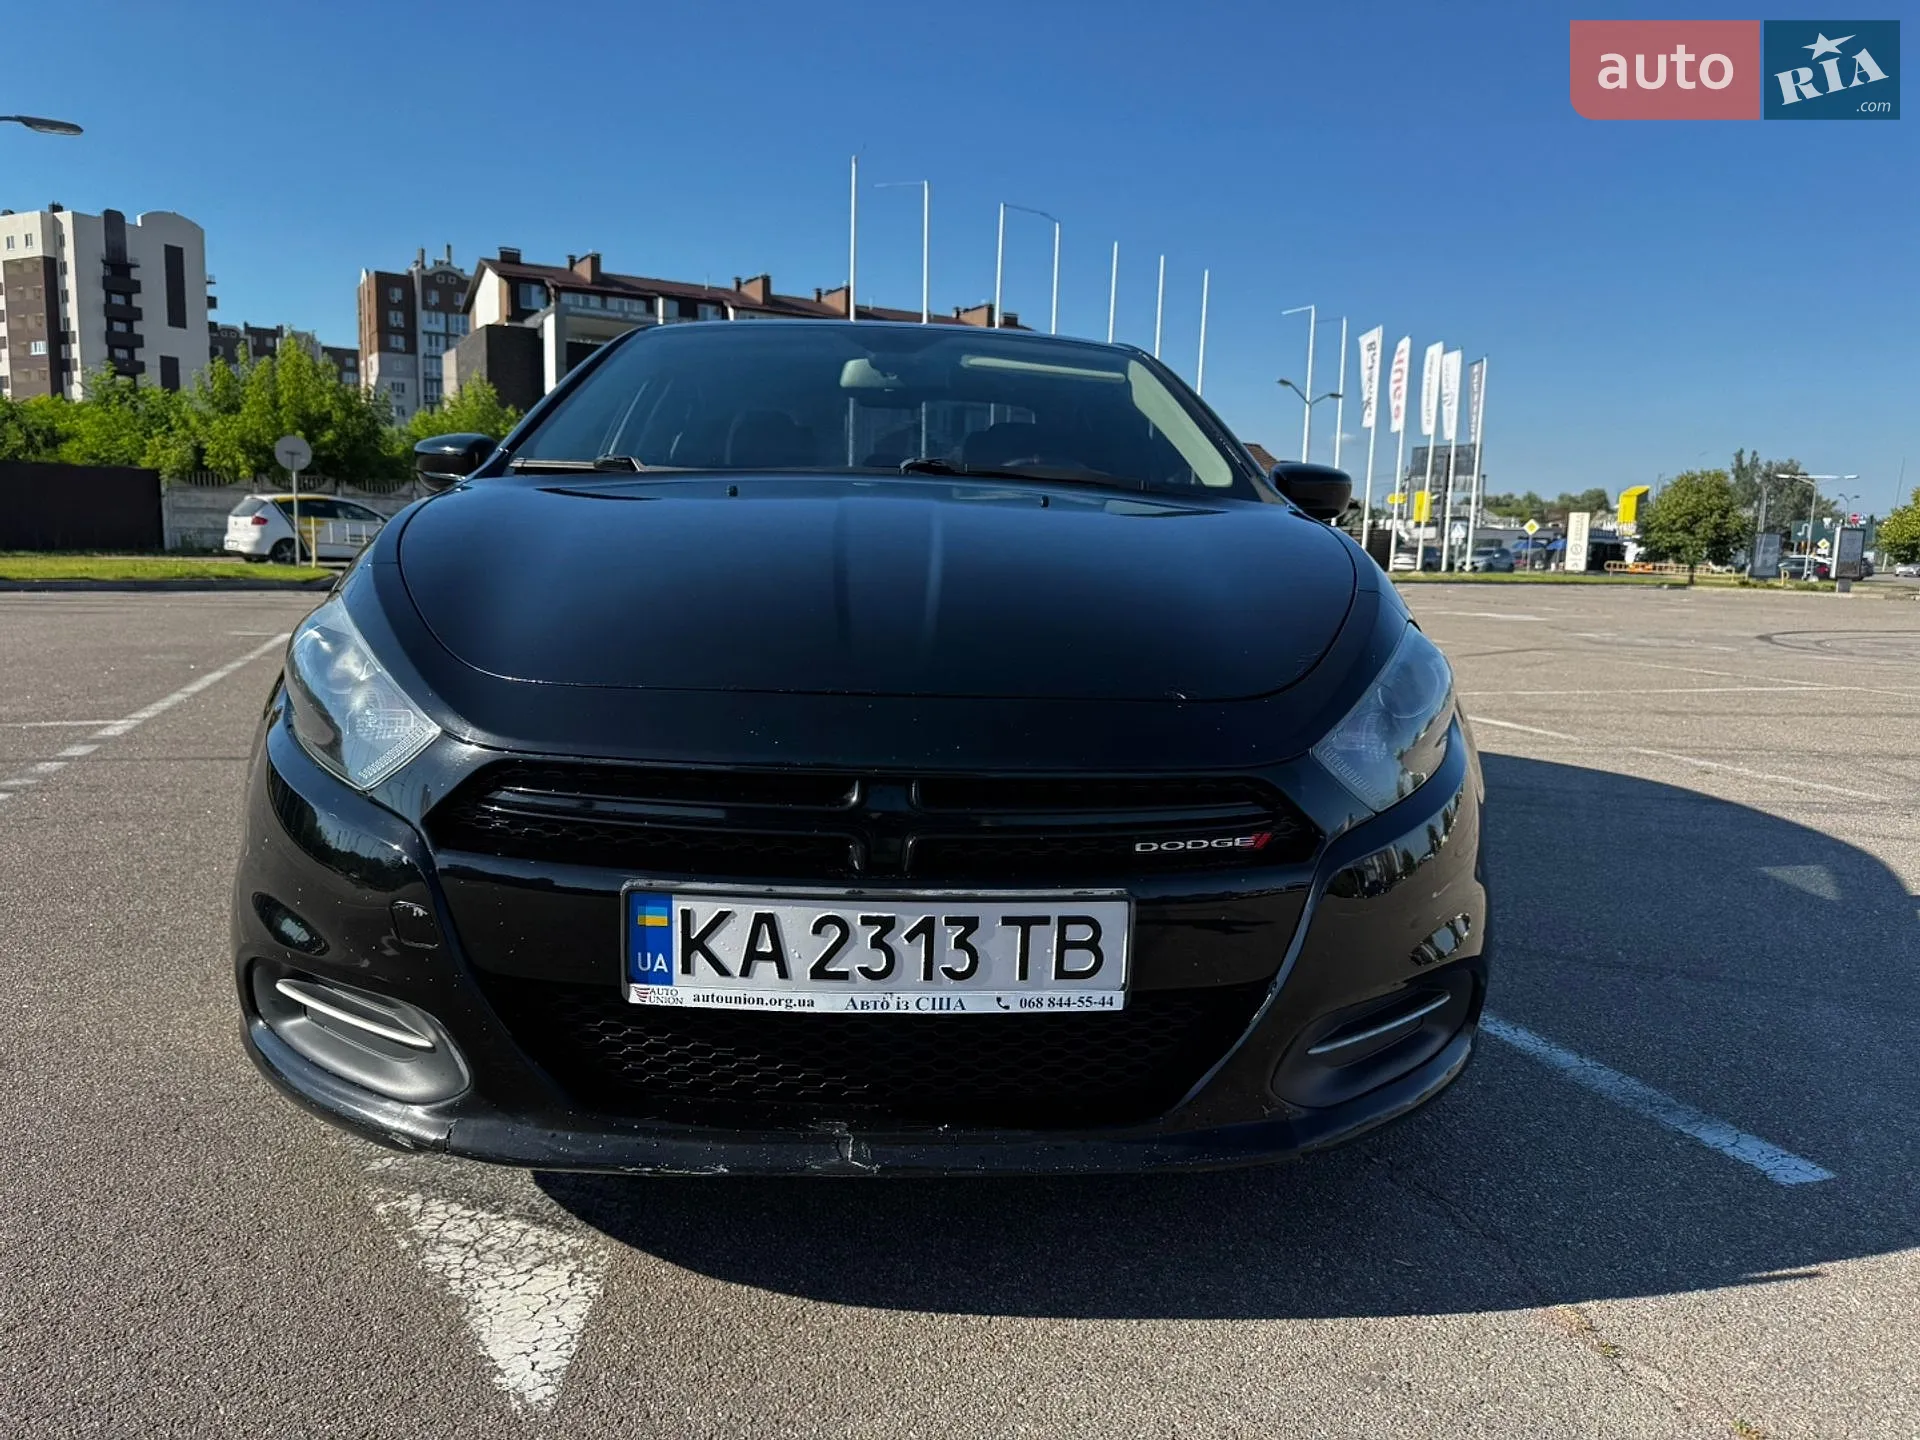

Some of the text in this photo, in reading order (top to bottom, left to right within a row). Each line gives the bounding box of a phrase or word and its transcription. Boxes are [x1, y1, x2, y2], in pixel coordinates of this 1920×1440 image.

[1135, 837, 1255, 852] DODGE
[680, 907, 1104, 981] KA 2313 TB
[637, 952, 668, 973] UA
[649, 987, 679, 997] AUTO
[648, 996, 684, 1005] UNION
[692, 992, 815, 1010] autounion.org.ua
[844, 995, 967, 1012] Авто із США
[1019, 994, 1114, 1009] 068 844-55-44
